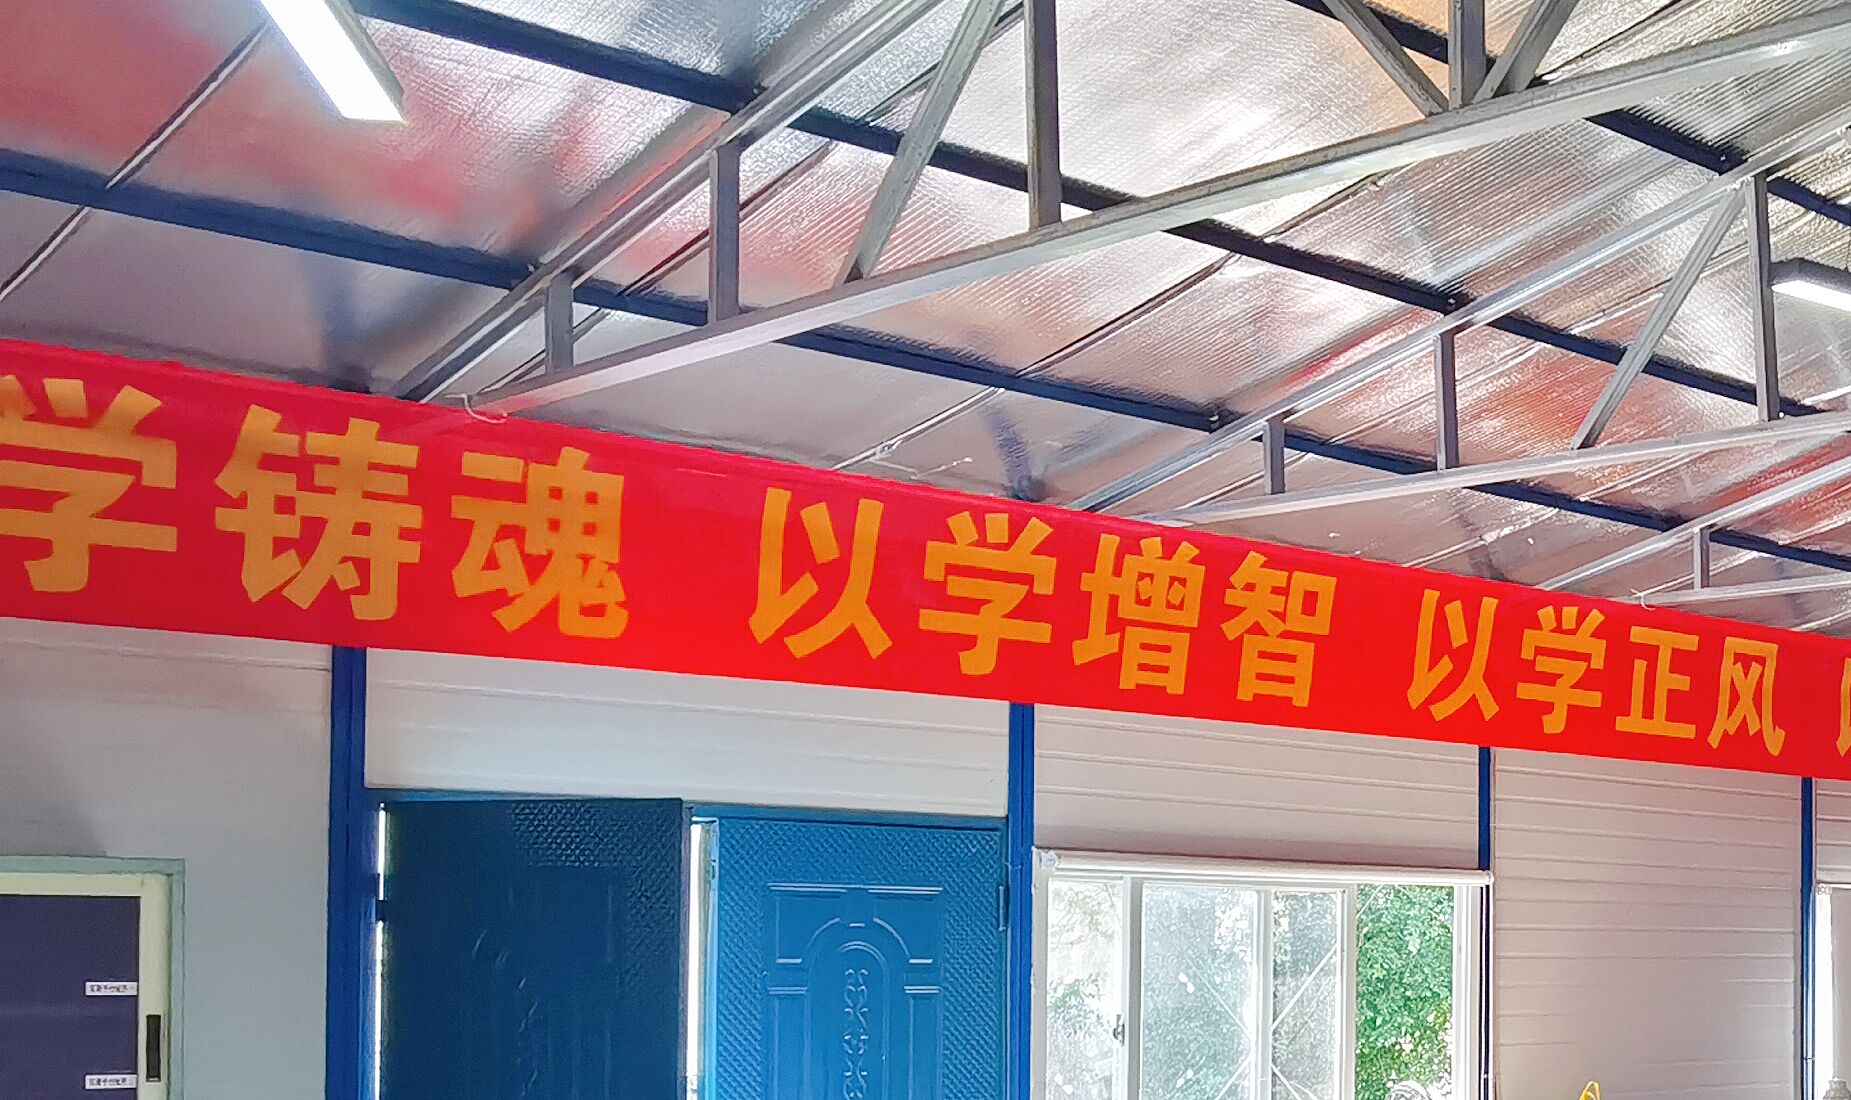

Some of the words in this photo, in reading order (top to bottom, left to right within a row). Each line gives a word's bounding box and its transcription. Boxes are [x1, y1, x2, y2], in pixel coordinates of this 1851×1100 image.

[0, 376, 628, 639] 学铸魂
[749, 487, 1338, 708] 以学增智
[1406, 588, 1786, 757] 以学正风
